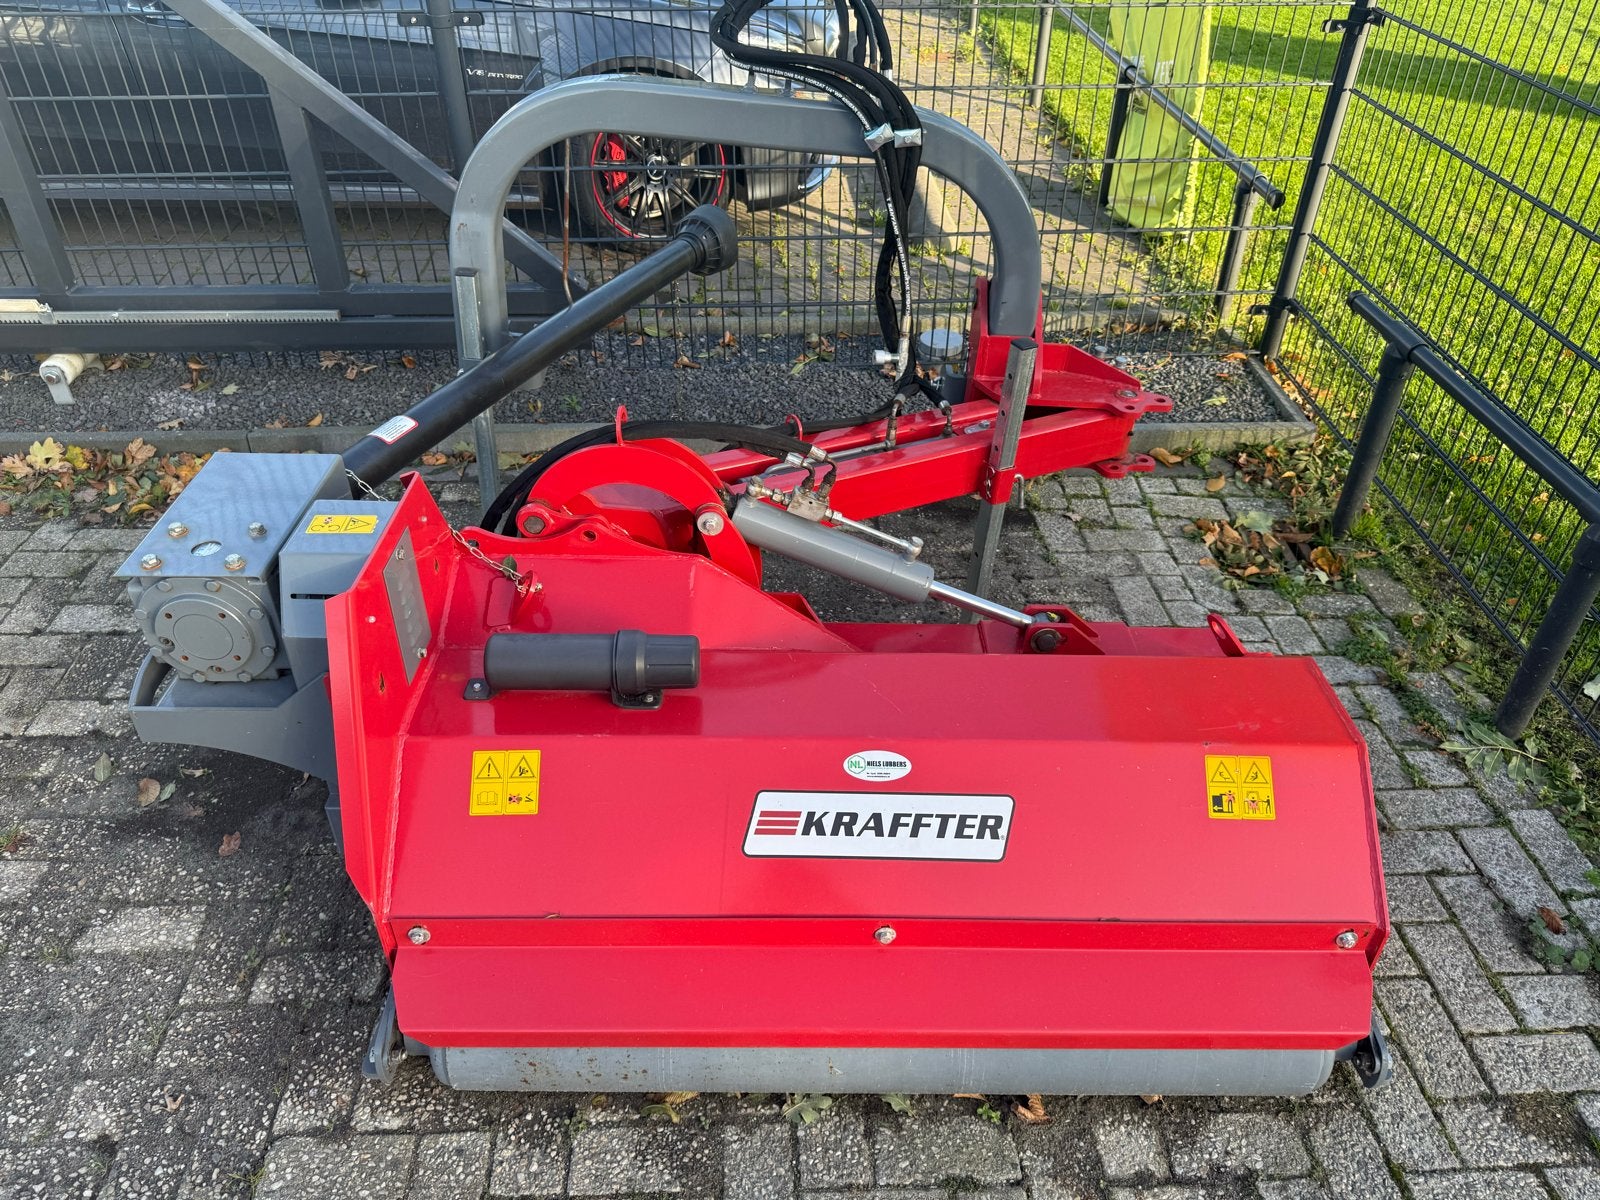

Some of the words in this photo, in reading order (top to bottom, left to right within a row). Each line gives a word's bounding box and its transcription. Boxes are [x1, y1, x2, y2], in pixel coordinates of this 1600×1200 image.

[793, 73, 804, 82] SAE
[849, 760, 863, 769] NL
[882, 760, 907, 768] LUBBERS
[801, 811, 1004, 840] KRAFFTER
